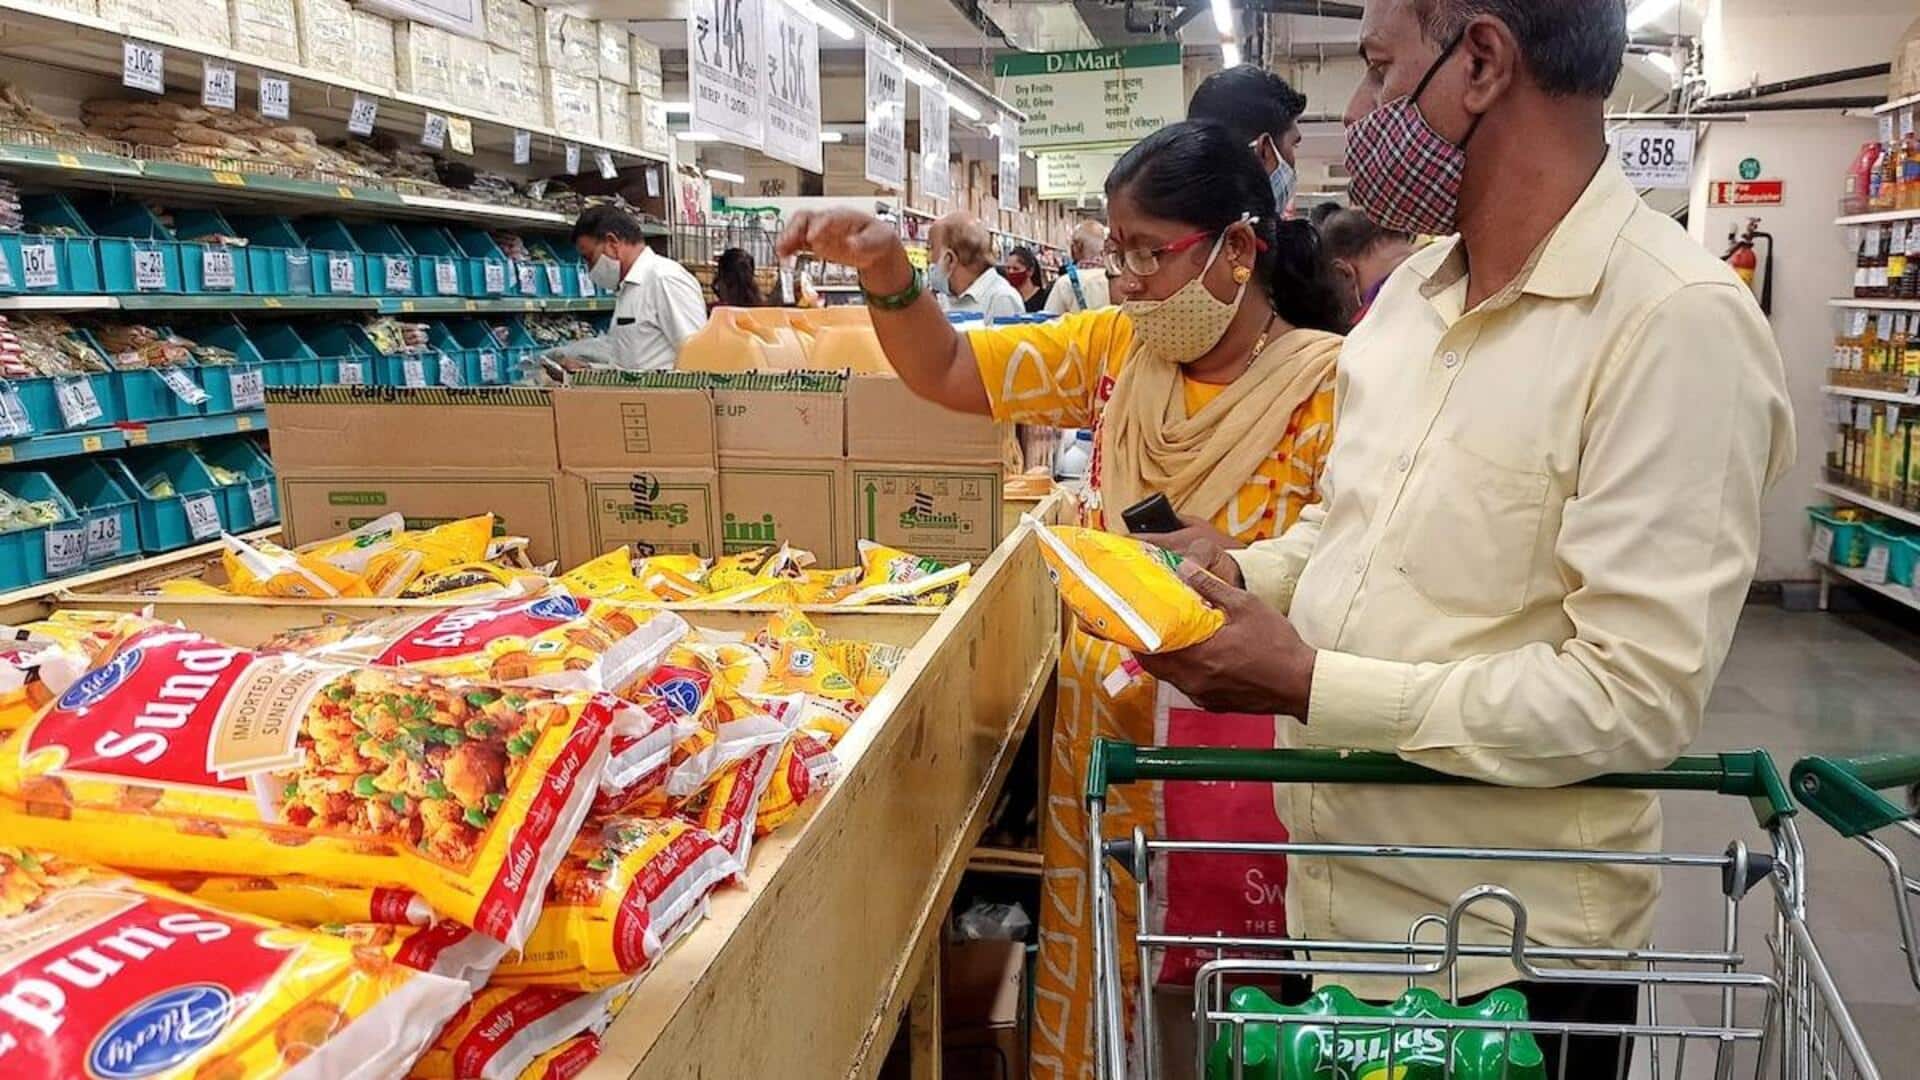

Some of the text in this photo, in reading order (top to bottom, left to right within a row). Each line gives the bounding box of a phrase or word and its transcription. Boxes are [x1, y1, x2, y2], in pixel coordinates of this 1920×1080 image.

[1015, 83, 1053, 95] Dry Fruits
[1028, 111, 1047, 121] sala
[729, 405, 747, 417] UP
[724, 512, 776, 541] ini
[94, 648, 242, 764] Sund
[231, 675, 273, 741] IMPORTED
[551, 751, 580, 796] Sunday
[503, 842, 535, 893] Sunday
[1245, 920, 1277, 933] THE
[0, 912, 233, 1042] Sund
[104, 990, 230, 1067] Liberty
[480, 1010, 514, 1042] Sunday
